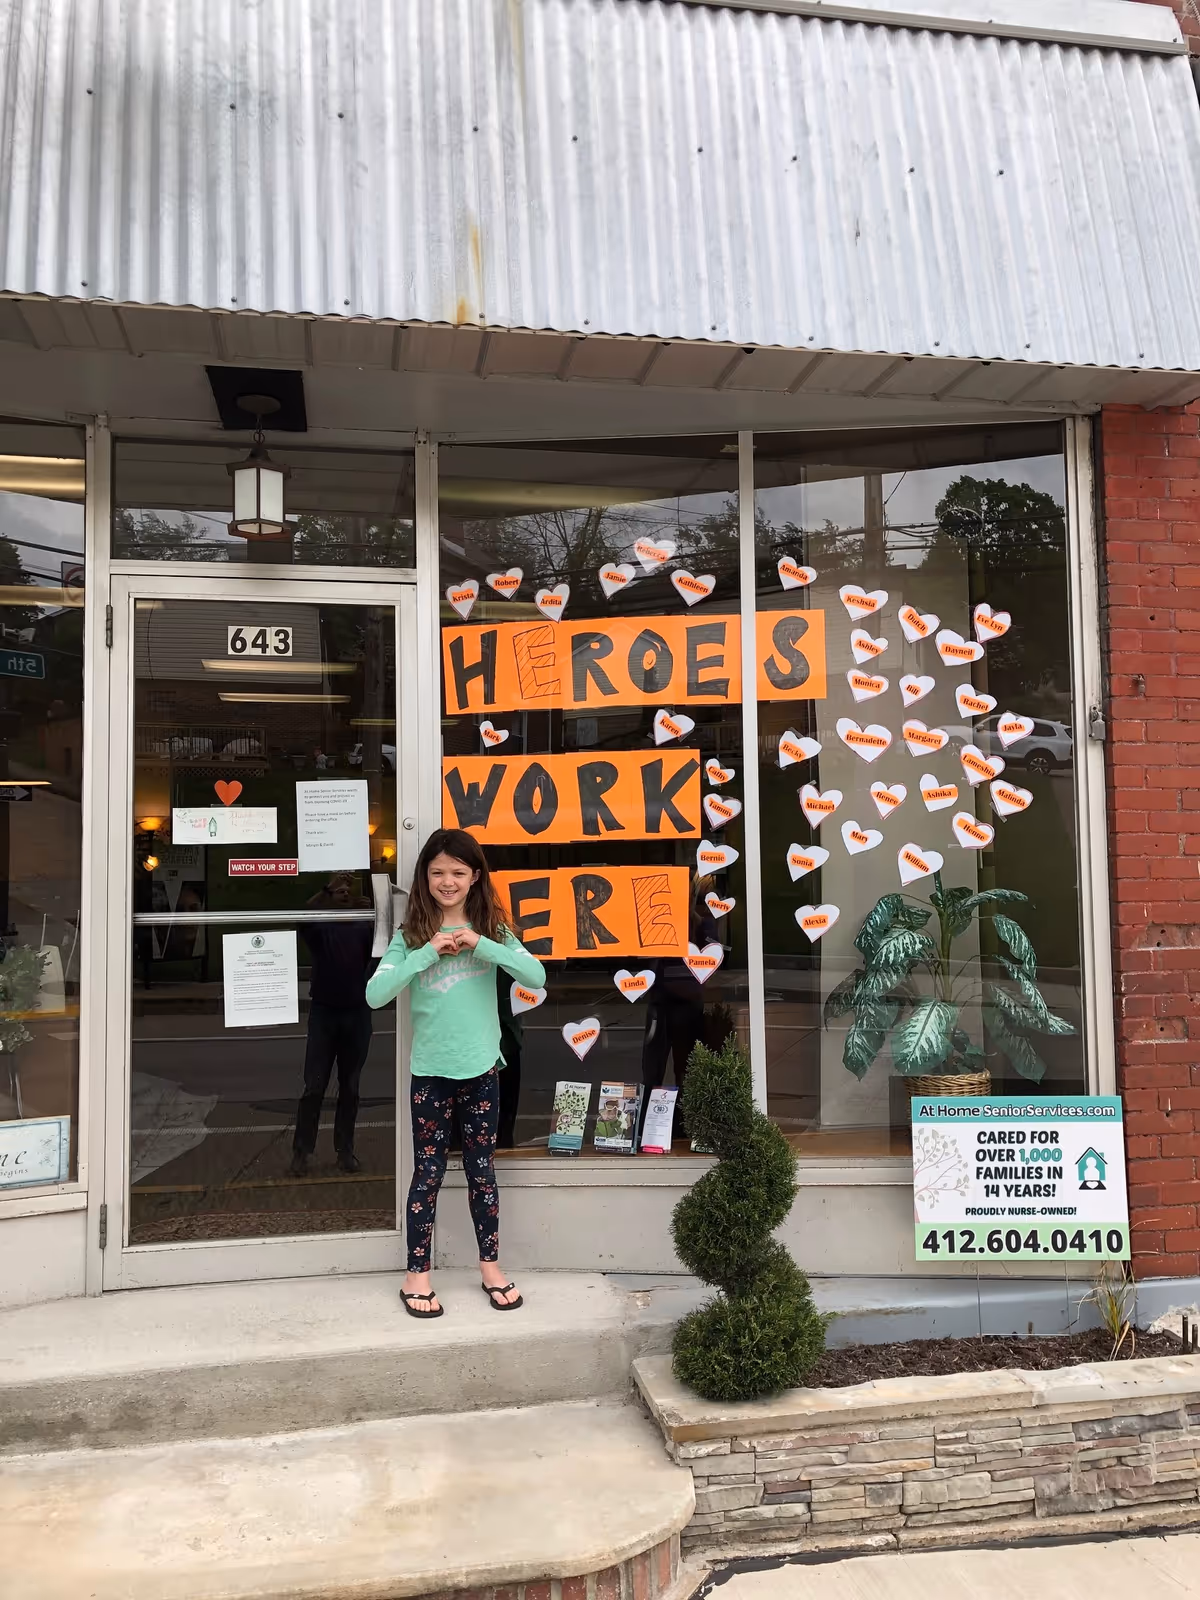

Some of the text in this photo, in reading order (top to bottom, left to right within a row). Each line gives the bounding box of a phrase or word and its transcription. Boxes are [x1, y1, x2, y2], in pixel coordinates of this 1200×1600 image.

[605, 572, 626, 583] Jamie
[779, 564, 808, 580] Amanda
[494, 578, 519, 587] Robert
[678, 576, 708, 593] Kathleen
[452, 592, 474, 603] Krista
[540, 597, 562, 606] Ardita
[846, 596, 875, 608] Keshsia
[907, 613, 926, 632] Dutch
[976, 614, 1004, 632] Eve Lyn
[229, 627, 291, 655] 643
[856, 640, 879, 655] Ashley
[449, 616, 810, 710] HEROES
[854, 678, 880, 689] Monica
[906, 684, 919, 696] Bill
[962, 698, 989, 711] Rachel
[659, 718, 679, 736] Karen
[1002, 723, 1023, 732] Jayla
[483, 729, 501, 742] Mark
[846, 734, 886, 746] Bernadette
[908, 731, 942, 745] Margaret
[782, 744, 803, 759] Becky
[962, 755, 995, 777] Lameshia
[708, 766, 726, 781] Cathy
[444, 758, 700, 836] WORK
[876, 792, 898, 805] Renee
[926, 789, 952, 798] Ashika
[997, 789, 1026, 807] Malinda
[708, 800, 732, 817] Tammy
[806, 802, 835, 811] Michael
[852, 830, 868, 844] Mary
[700, 854, 725, 862] Bernie
[792, 856, 813, 867] Sonia
[904, 852, 929, 873] William
[231, 863, 296, 872] WATCH YOUR STEP
[508, 874, 679, 956] ERE
[804, 917, 826, 926] Alexia
[688, 958, 716, 966] Pamela
[624, 979, 644, 988] Linda
[518, 991, 536, 1003] Mark
[572, 1029, 596, 1044] Denise
[919, 1104, 1115, 1117] At Home SeniorServices.com
[977, 1131, 1060, 1145] CARED FOR
[975, 1148, 1062, 1164] OVER 1,000
[975, 1166, 1063, 1180] FAMILIES IN
[983, 1184, 1057, 1198] 14 YEARS!
[965, 1207, 1077, 1216] PROUDLY NURSE-OWNED!
[922, 1229, 1124, 1254] 412.604.0410
